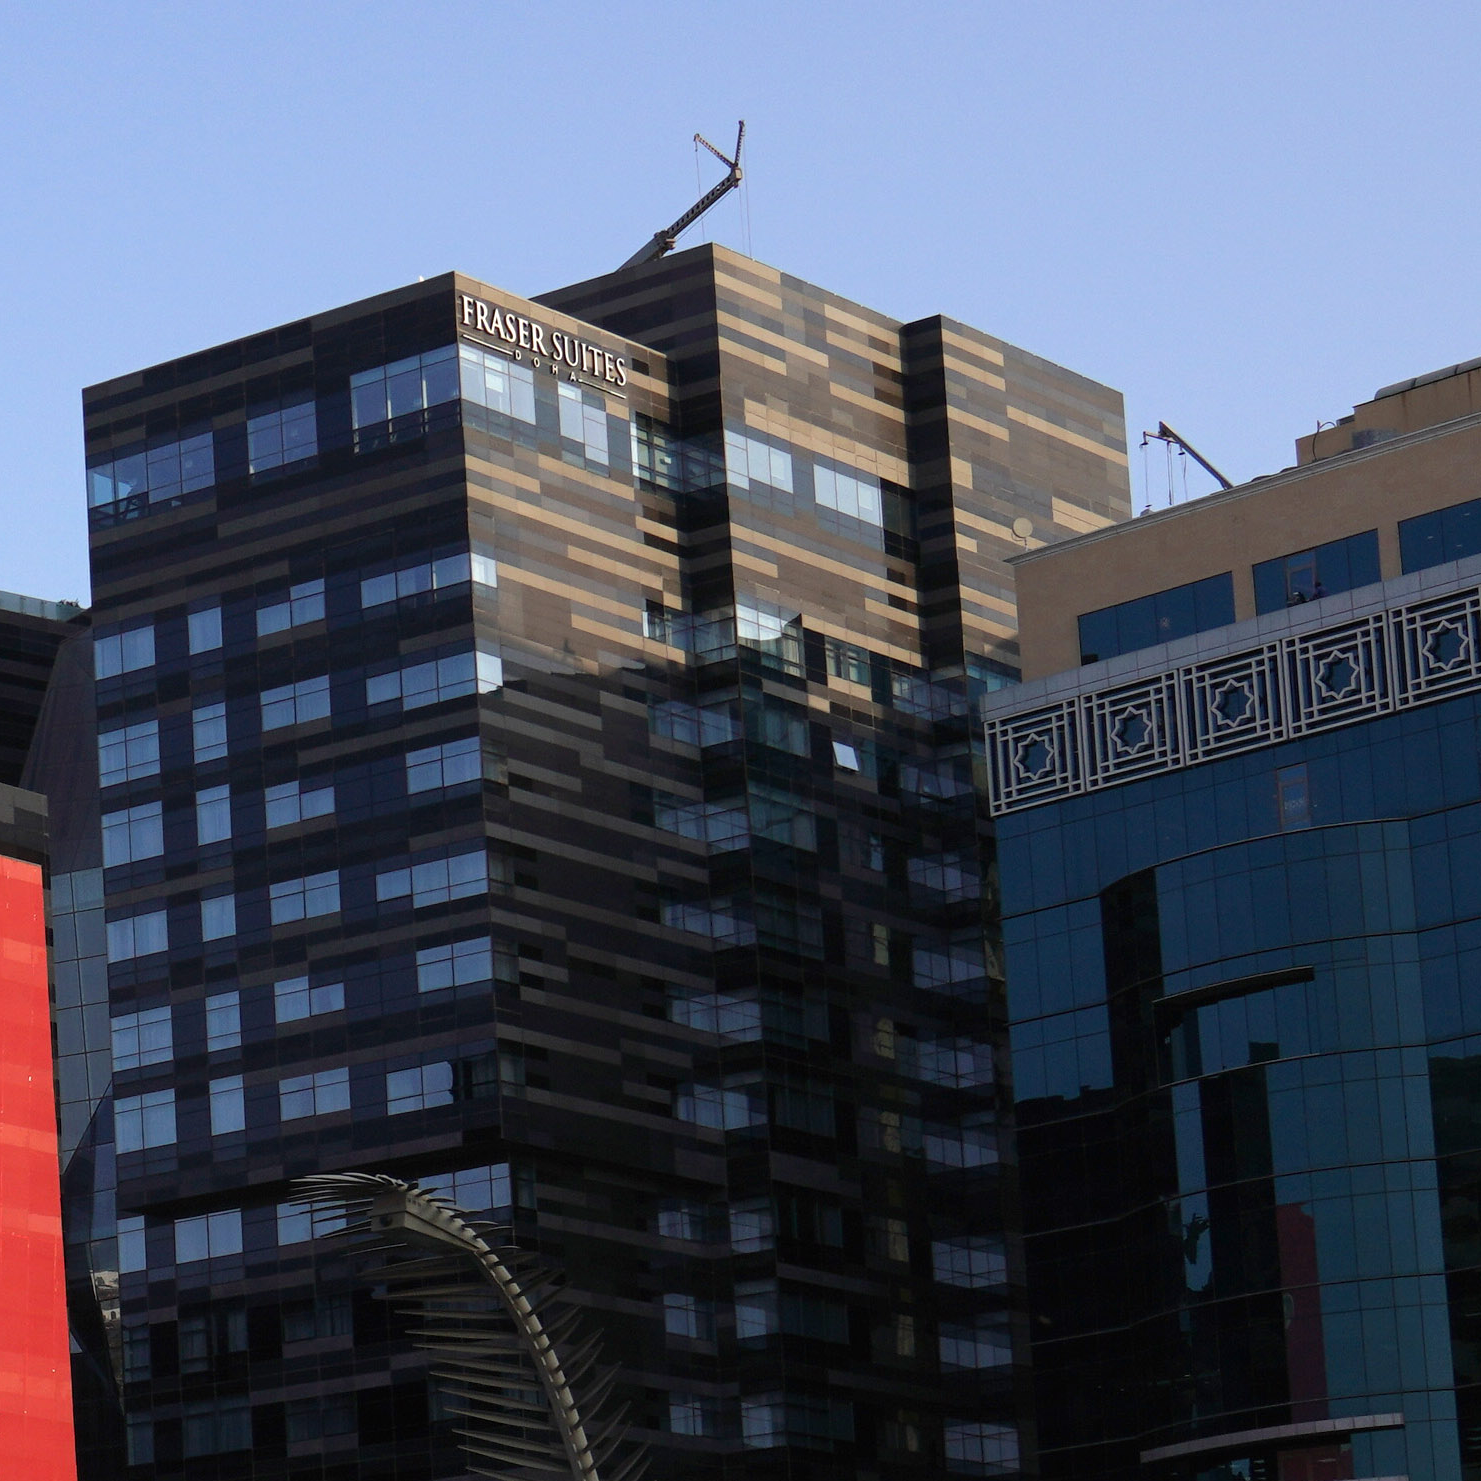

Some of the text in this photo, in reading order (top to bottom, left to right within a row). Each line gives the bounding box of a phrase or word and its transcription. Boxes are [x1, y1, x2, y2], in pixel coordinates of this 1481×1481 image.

[461, 294, 627, 387] FRASER SUITES
[513, 349, 577, 382] DOHA
